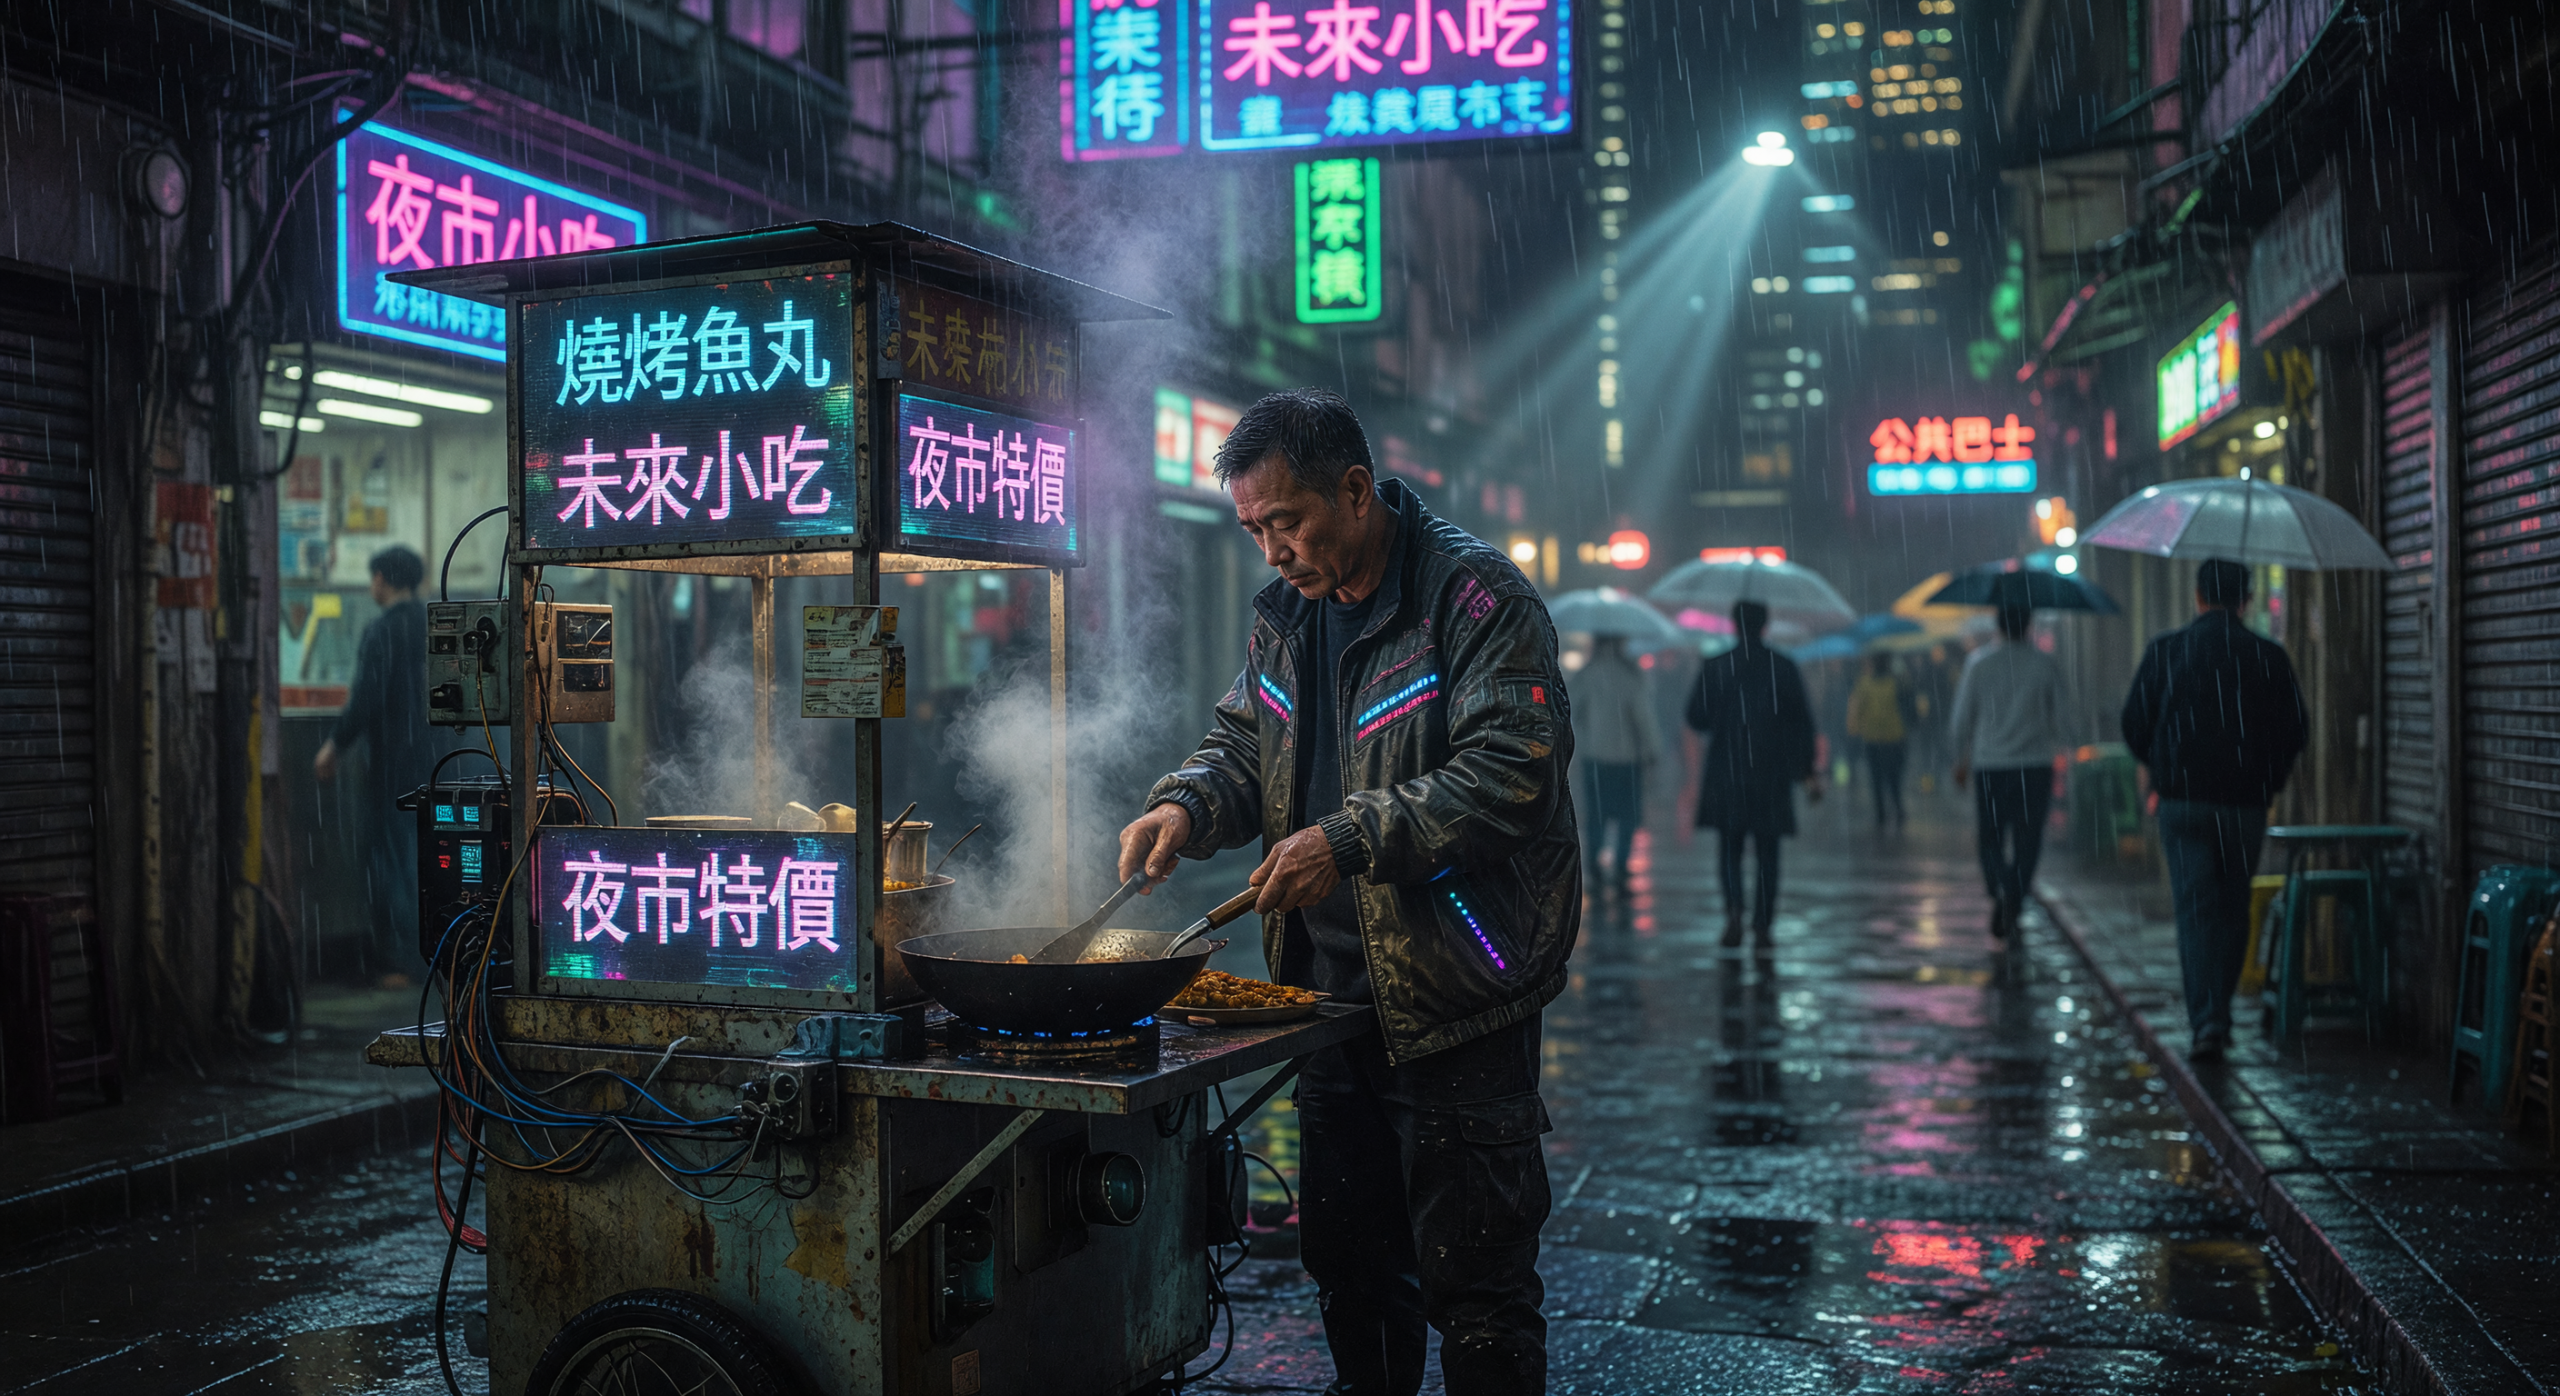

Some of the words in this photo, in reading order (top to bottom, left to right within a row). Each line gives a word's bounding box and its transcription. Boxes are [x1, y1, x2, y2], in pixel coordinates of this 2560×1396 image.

[1223, 0, 1549, 87] 未來小吃
[556, 300, 832, 406] 燒烤魚丸
[557, 425, 832, 529] 未來小吃
[908, 416, 1066, 526] 夜市特價
[1869, 413, 2036, 464] 公共巴士
[562, 851, 841, 952] 夜市特價
